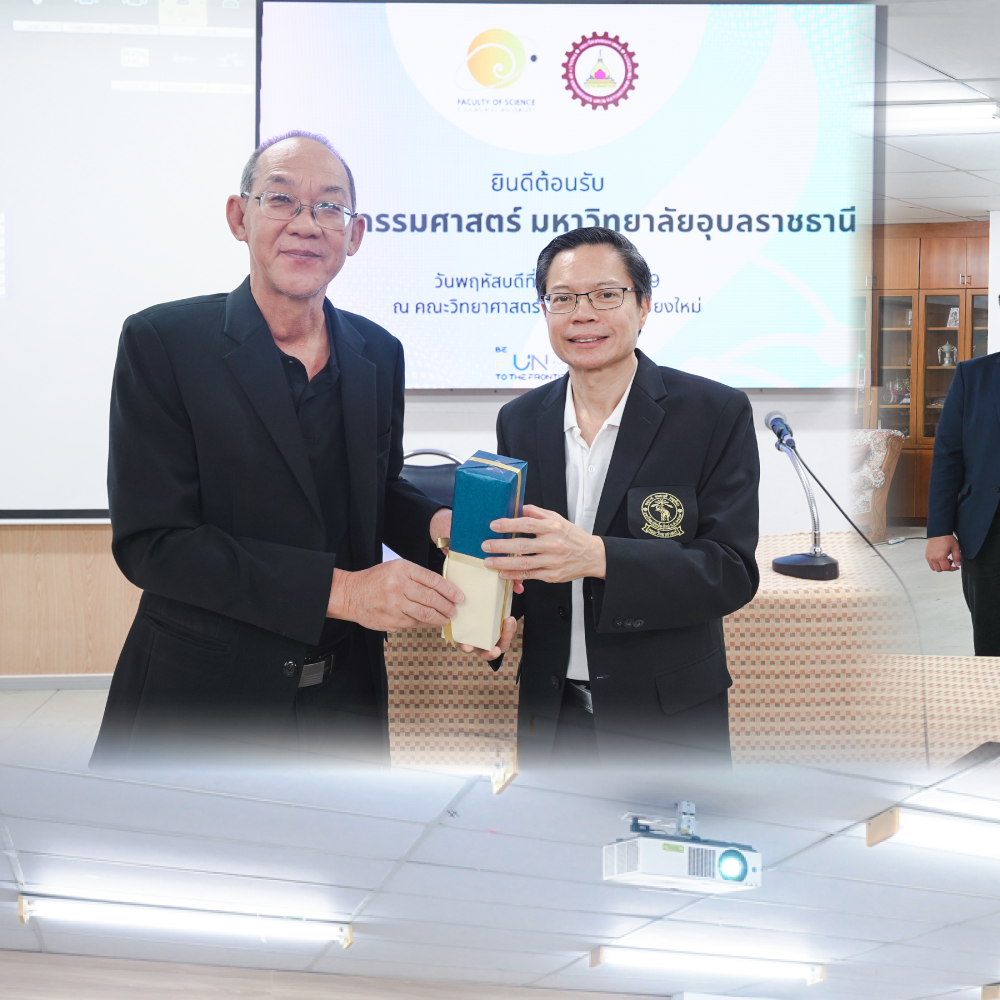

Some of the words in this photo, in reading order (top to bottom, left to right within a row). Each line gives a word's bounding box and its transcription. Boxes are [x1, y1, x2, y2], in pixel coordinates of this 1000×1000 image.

[491, 171, 604, 192] ยินดีต้อนรับ
[531, 206, 856, 241] มหาวิทยาลัยอุบลราชธานี
[393, 302, 409, 314] ณ
[415, 299, 541, 314] คณะวิทยาศาสตร
[495, 373, 508, 381] TO
[509, 373, 527, 381] THE
